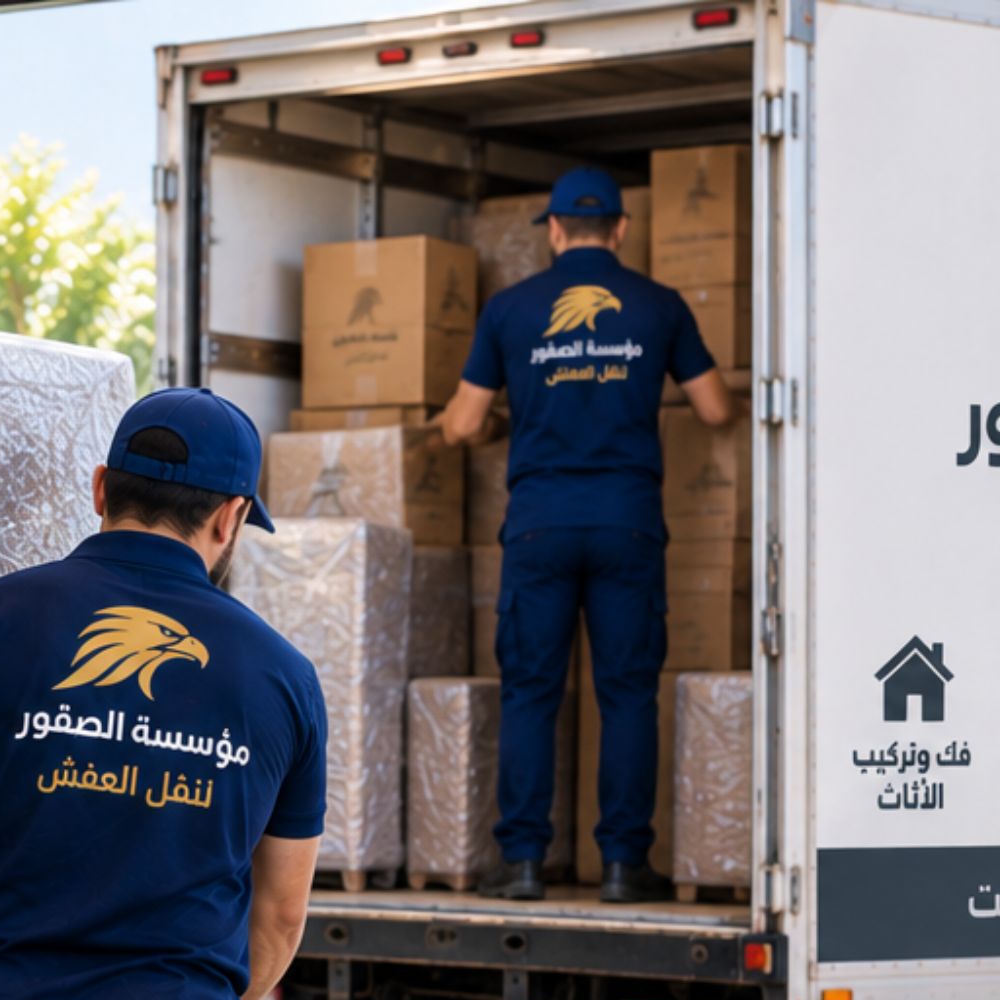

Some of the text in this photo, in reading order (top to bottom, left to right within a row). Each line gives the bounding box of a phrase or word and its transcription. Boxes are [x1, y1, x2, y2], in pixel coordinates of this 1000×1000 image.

[14, 703, 250, 769] مؤسسة الصقور
[852, 741, 971, 775] فك وتركيب
[36, 756, 214, 808] لنقل العفش
[877, 777, 944, 809] الأثاث
